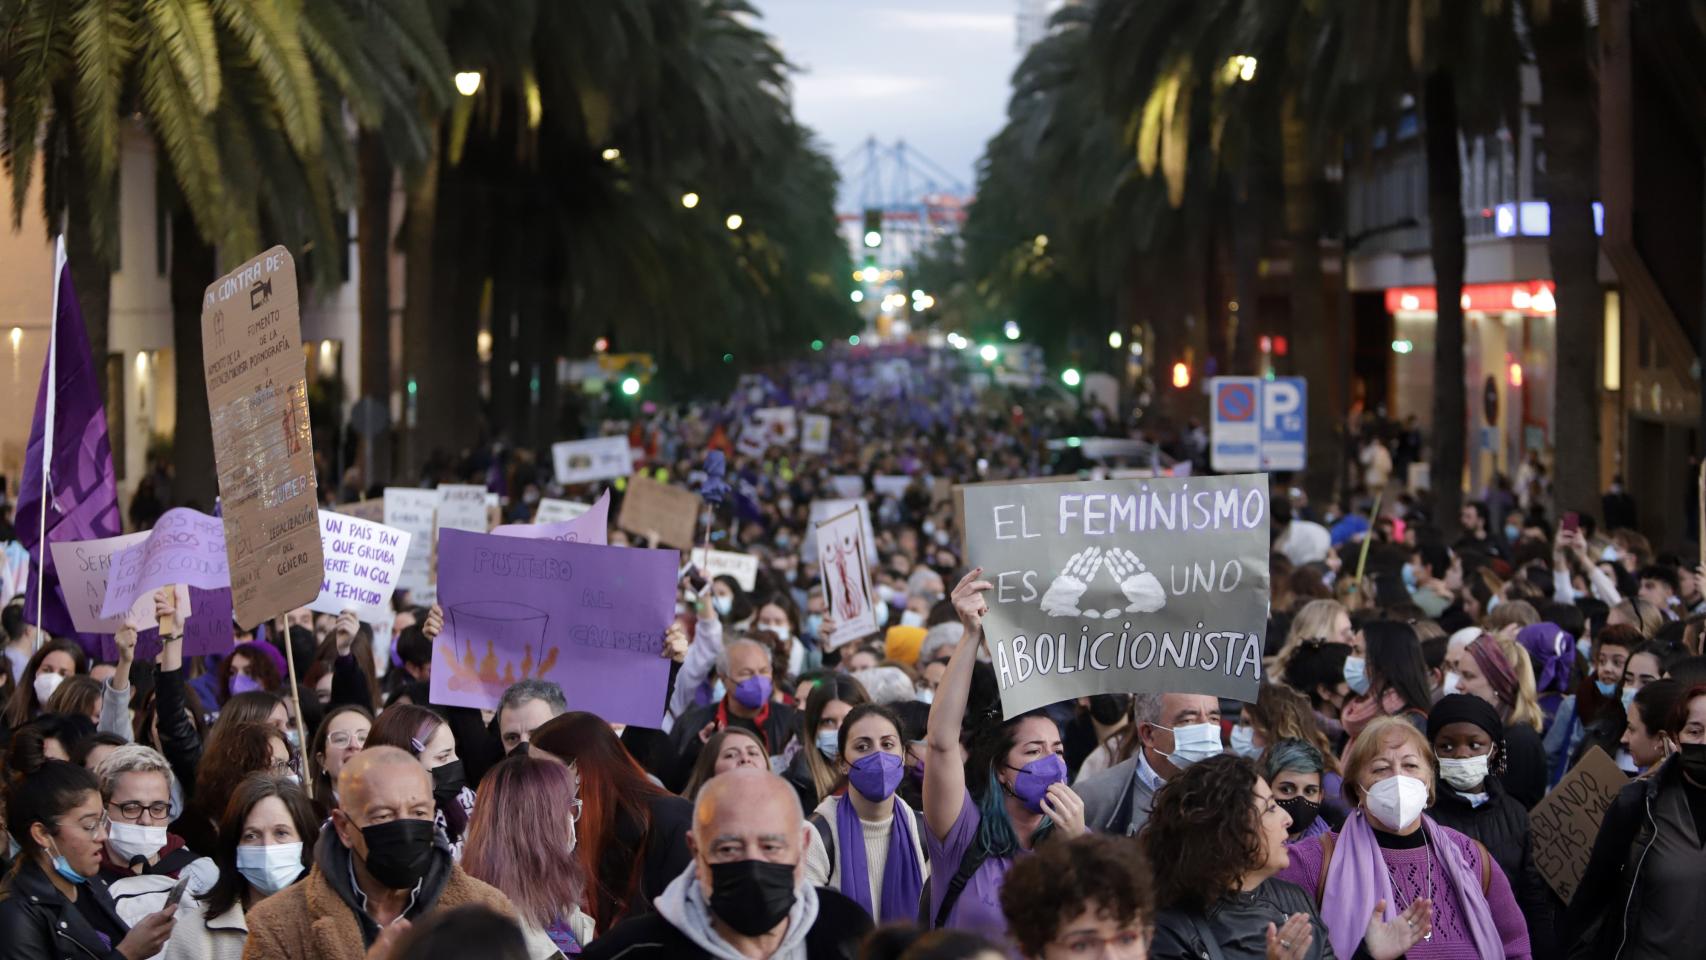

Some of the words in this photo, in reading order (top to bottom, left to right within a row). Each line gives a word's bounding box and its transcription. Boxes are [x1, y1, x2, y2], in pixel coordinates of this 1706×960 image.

[218, 261, 263, 302] CONTRA
[247, 309, 280, 337] FOMENTO
[258, 333, 268, 346] DE
[268, 328, 279, 342] LA
[265, 377, 274, 389] LA
[1263, 382, 1300, 431] P
[325, 518, 344, 535] UN
[379, 531, 400, 547] TAN
[993, 504, 1042, 540] EL
[332, 539, 356, 556] QUE
[357, 544, 395, 566] GRITABA
[474, 547, 573, 581] PUTERO
[324, 558, 350, 575] ERTE
[353, 562, 370, 578] UN
[370, 566, 390, 585] GOL
[997, 570, 1038, 604] ES
[1170, 559, 1243, 597] UNO
[580, 586, 616, 610] AL
[1530, 770, 1598, 850] ABLANDO
[1536, 823, 1588, 880] ESTAS
